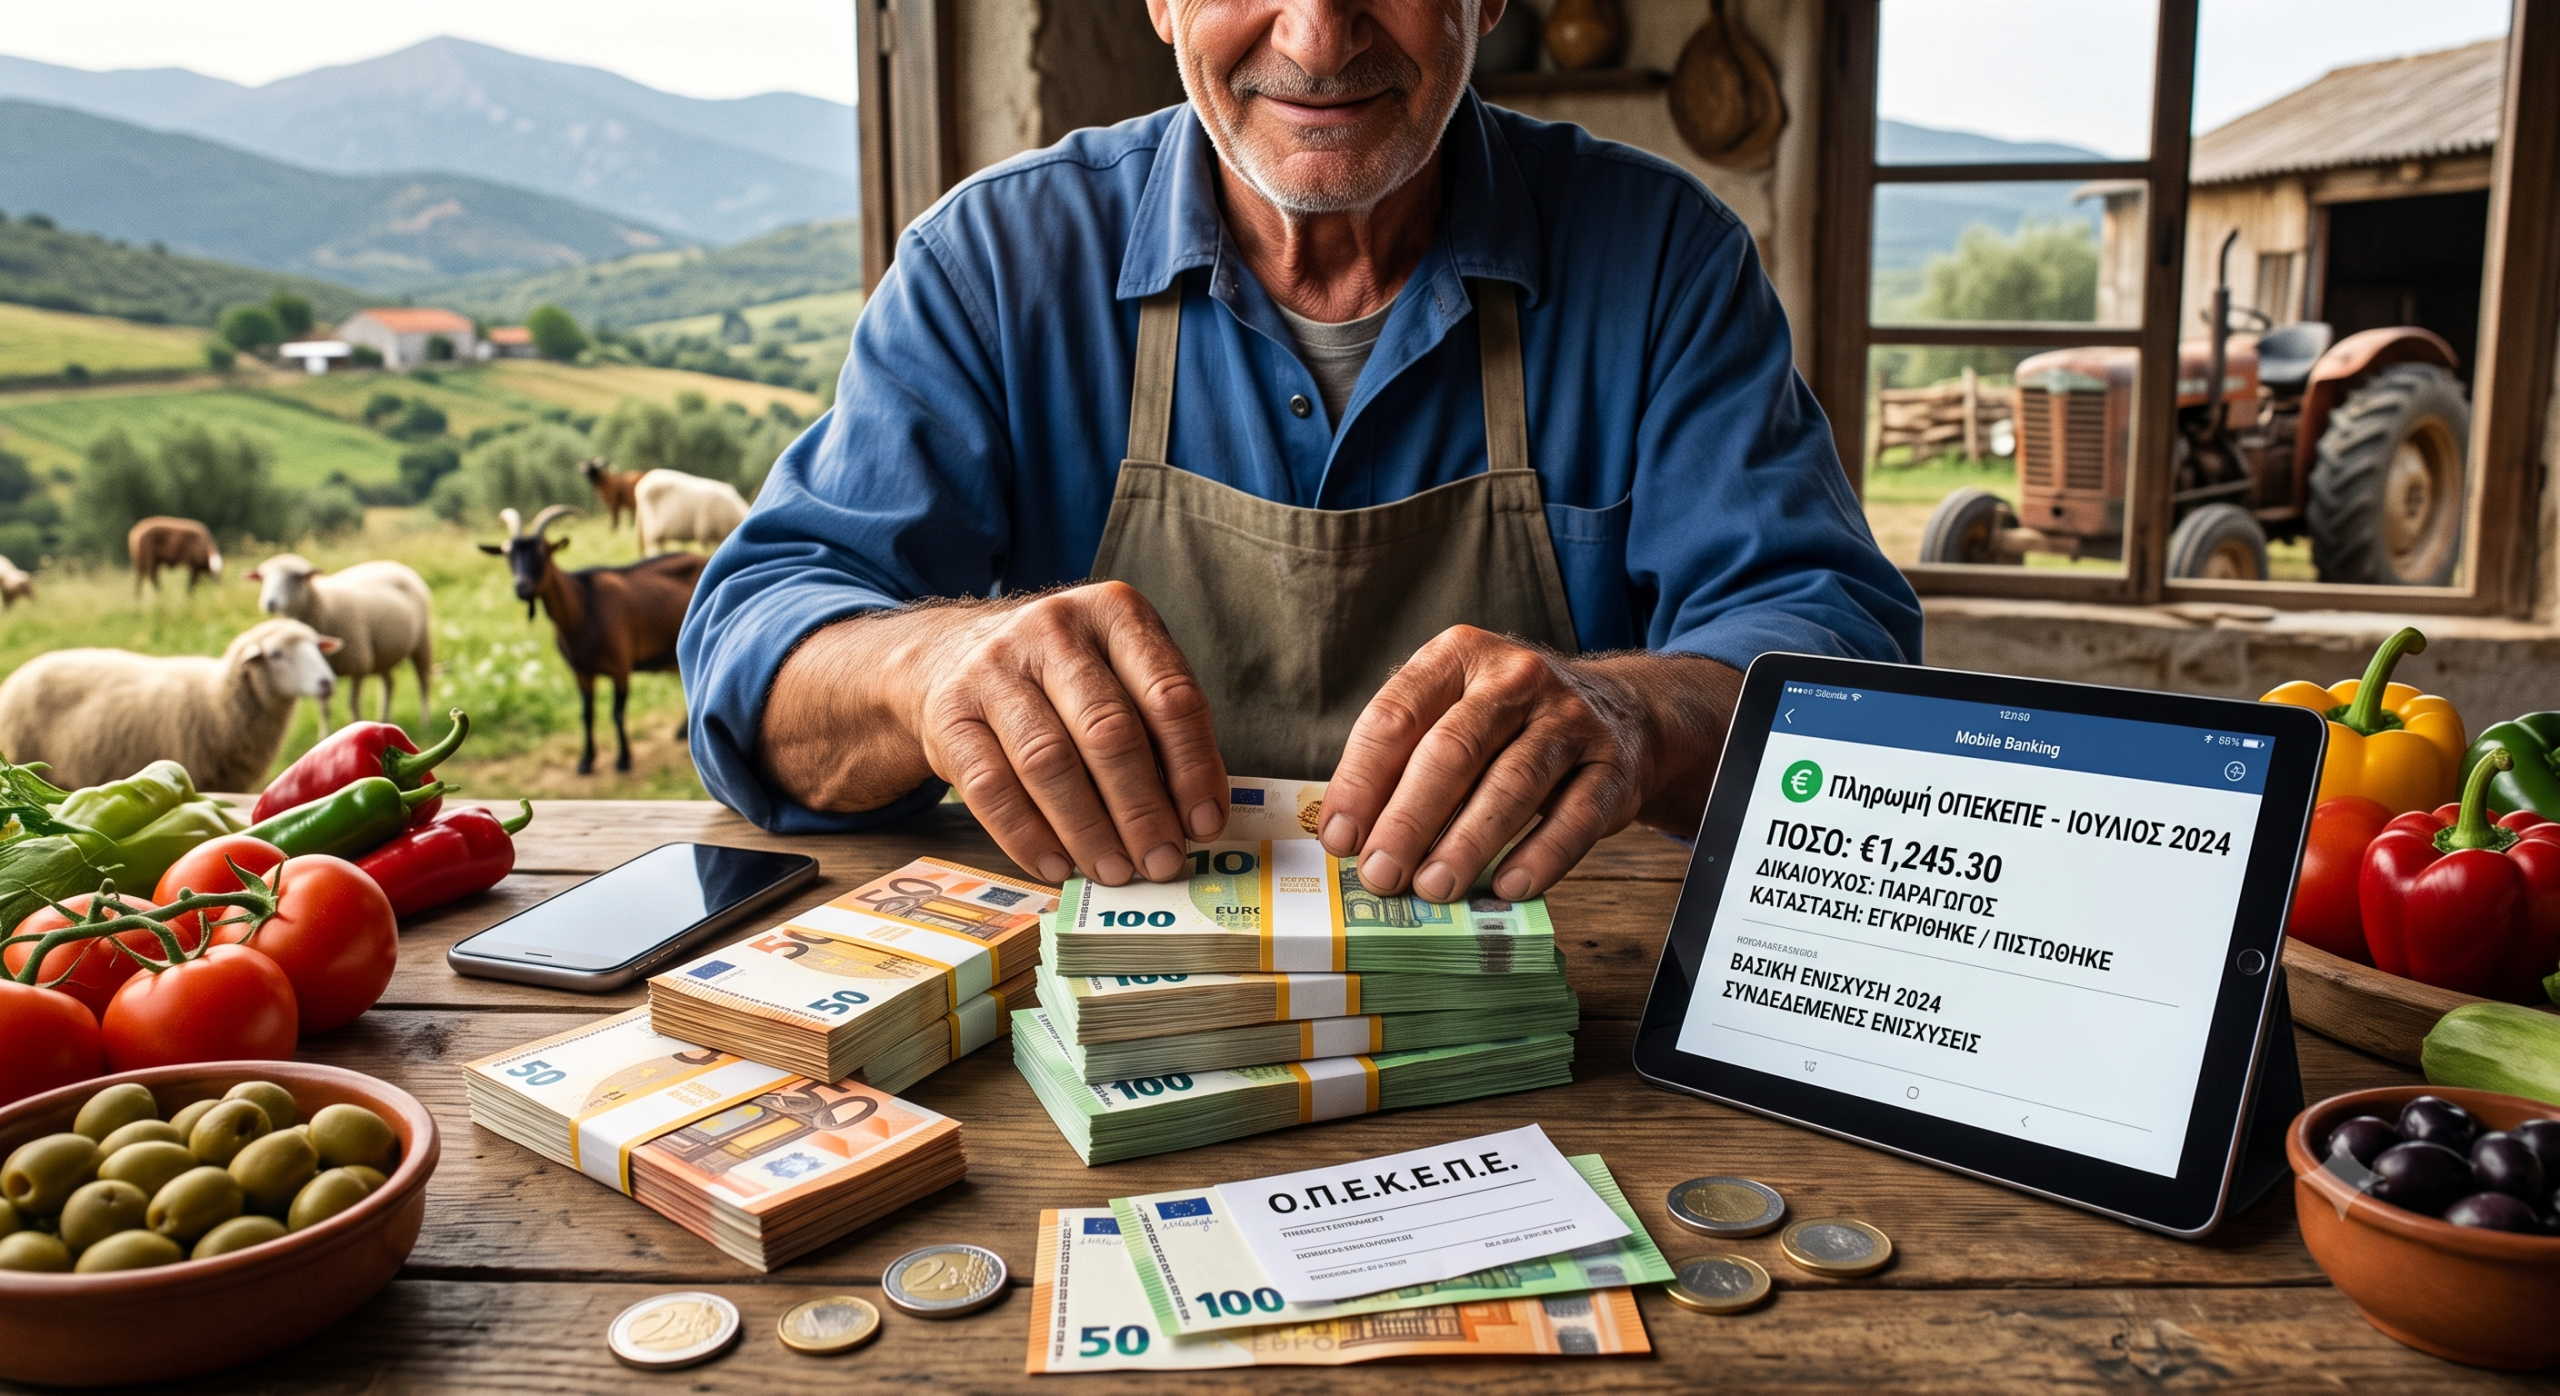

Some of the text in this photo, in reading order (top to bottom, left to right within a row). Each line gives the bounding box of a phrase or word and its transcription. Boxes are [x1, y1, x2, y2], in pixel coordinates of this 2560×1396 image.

[1955, 730, 2060, 758] Mobile Banking
[1829, 775, 1932, 816] Πληρωμή
[1937, 791, 2046, 828] ΟΠΕΚΕΠΕ
[2067, 810, 2165, 846] ΙΟΥΛΙΟΣ
[2169, 825, 2231, 856] 2024
[1186, 850, 1260, 875] 10
[1766, 819, 2003, 883] ΠΟΣΟ: €1,245.30
[1755, 858, 1998, 918] ΔΙΚΑΙΟΥΧΟΣ: ΠΑΡΑΓΩΓΟΣ
[1097, 910, 1176, 928] 100
[1749, 885, 1864, 924] ΚΑΤΑΣΤΑΣΗ:
[1867, 908, 1977, 945] ΕΓΚΡΙΘΗΚΕ
[1993, 931, 2113, 971] ΠΙΣΤΩΘΗΚΕ
[1730, 953, 1942, 1014] ΒΑΣΙΚΗ ΕΝΙΣΧΥΣΗ 2024
[806, 990, 870, 1016] 50
[1722, 980, 1981, 1054] ΣΥΝΔΕΔΕΜΕΝΕΣ ΕΝΙΣΧΥΣΕΙΣ
[506, 1060, 567, 1086] 50
[1111, 1073, 1194, 1100] 100
[1268, 1151, 1519, 1214] Ο.Π.Ε.Κ.Ε.Π.Ε.
[1195, 1287, 1285, 1318] 100
[1079, 1325, 1150, 1358] 50
